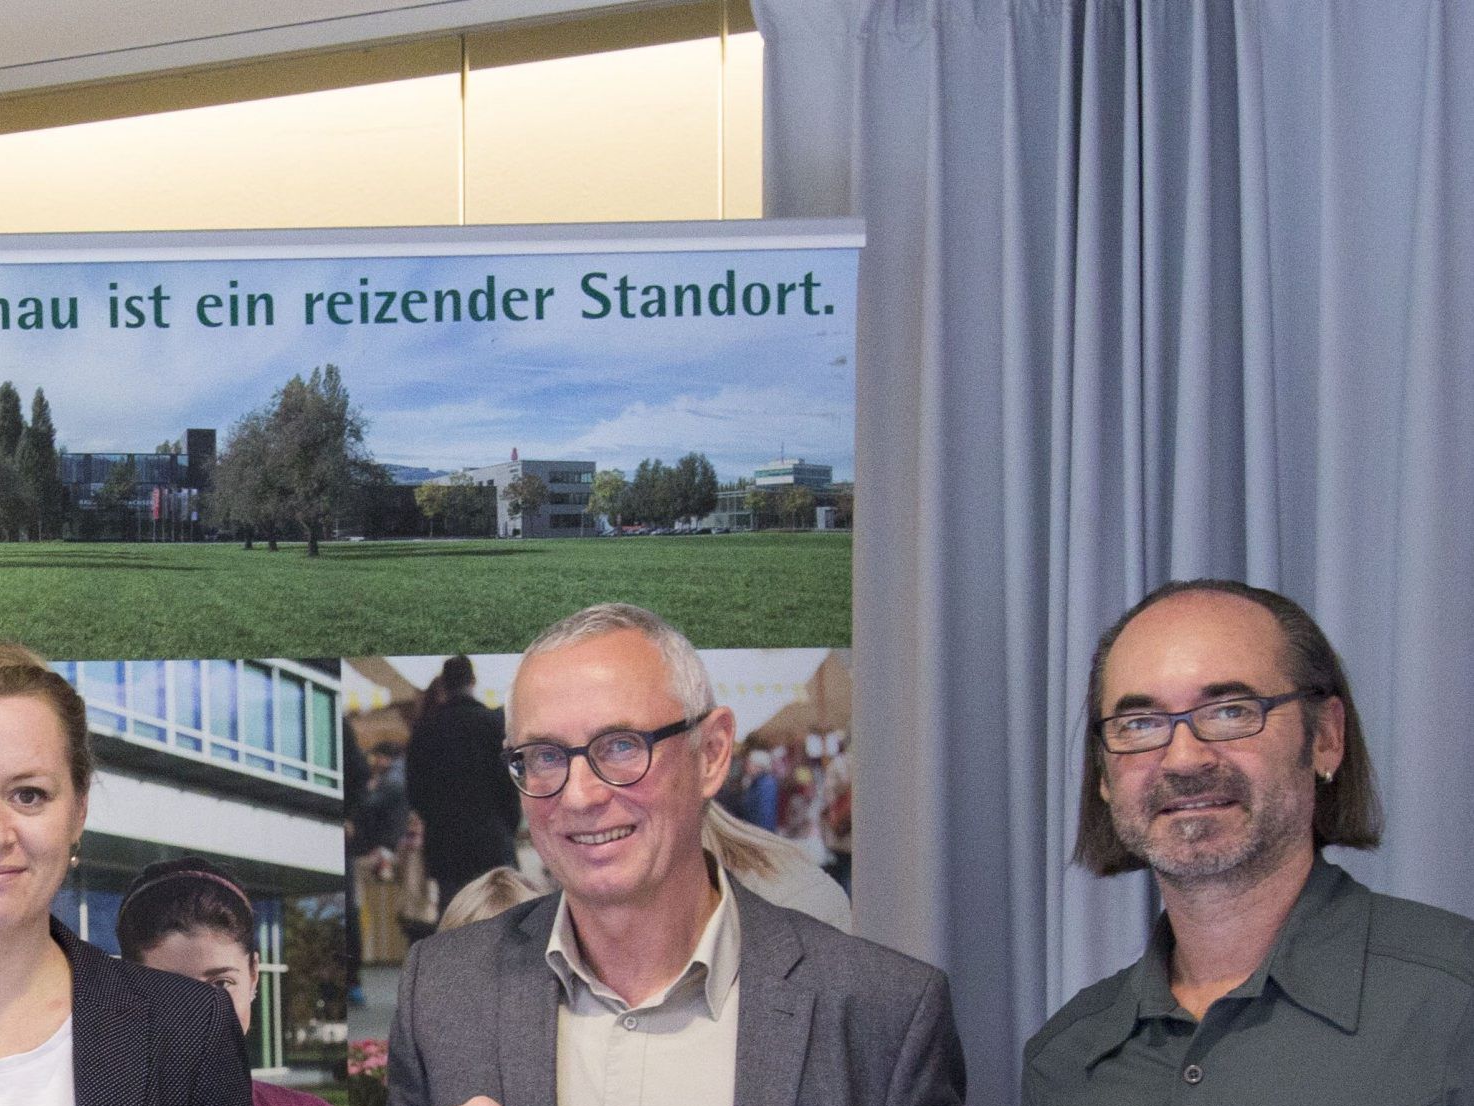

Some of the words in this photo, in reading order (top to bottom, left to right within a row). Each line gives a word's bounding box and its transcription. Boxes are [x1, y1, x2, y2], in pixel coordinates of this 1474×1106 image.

[109, 282, 170, 329] ist
[196, 280, 275, 327] ein
[305, 275, 555, 325] reizender
[580, 270, 835, 320] Standort.
